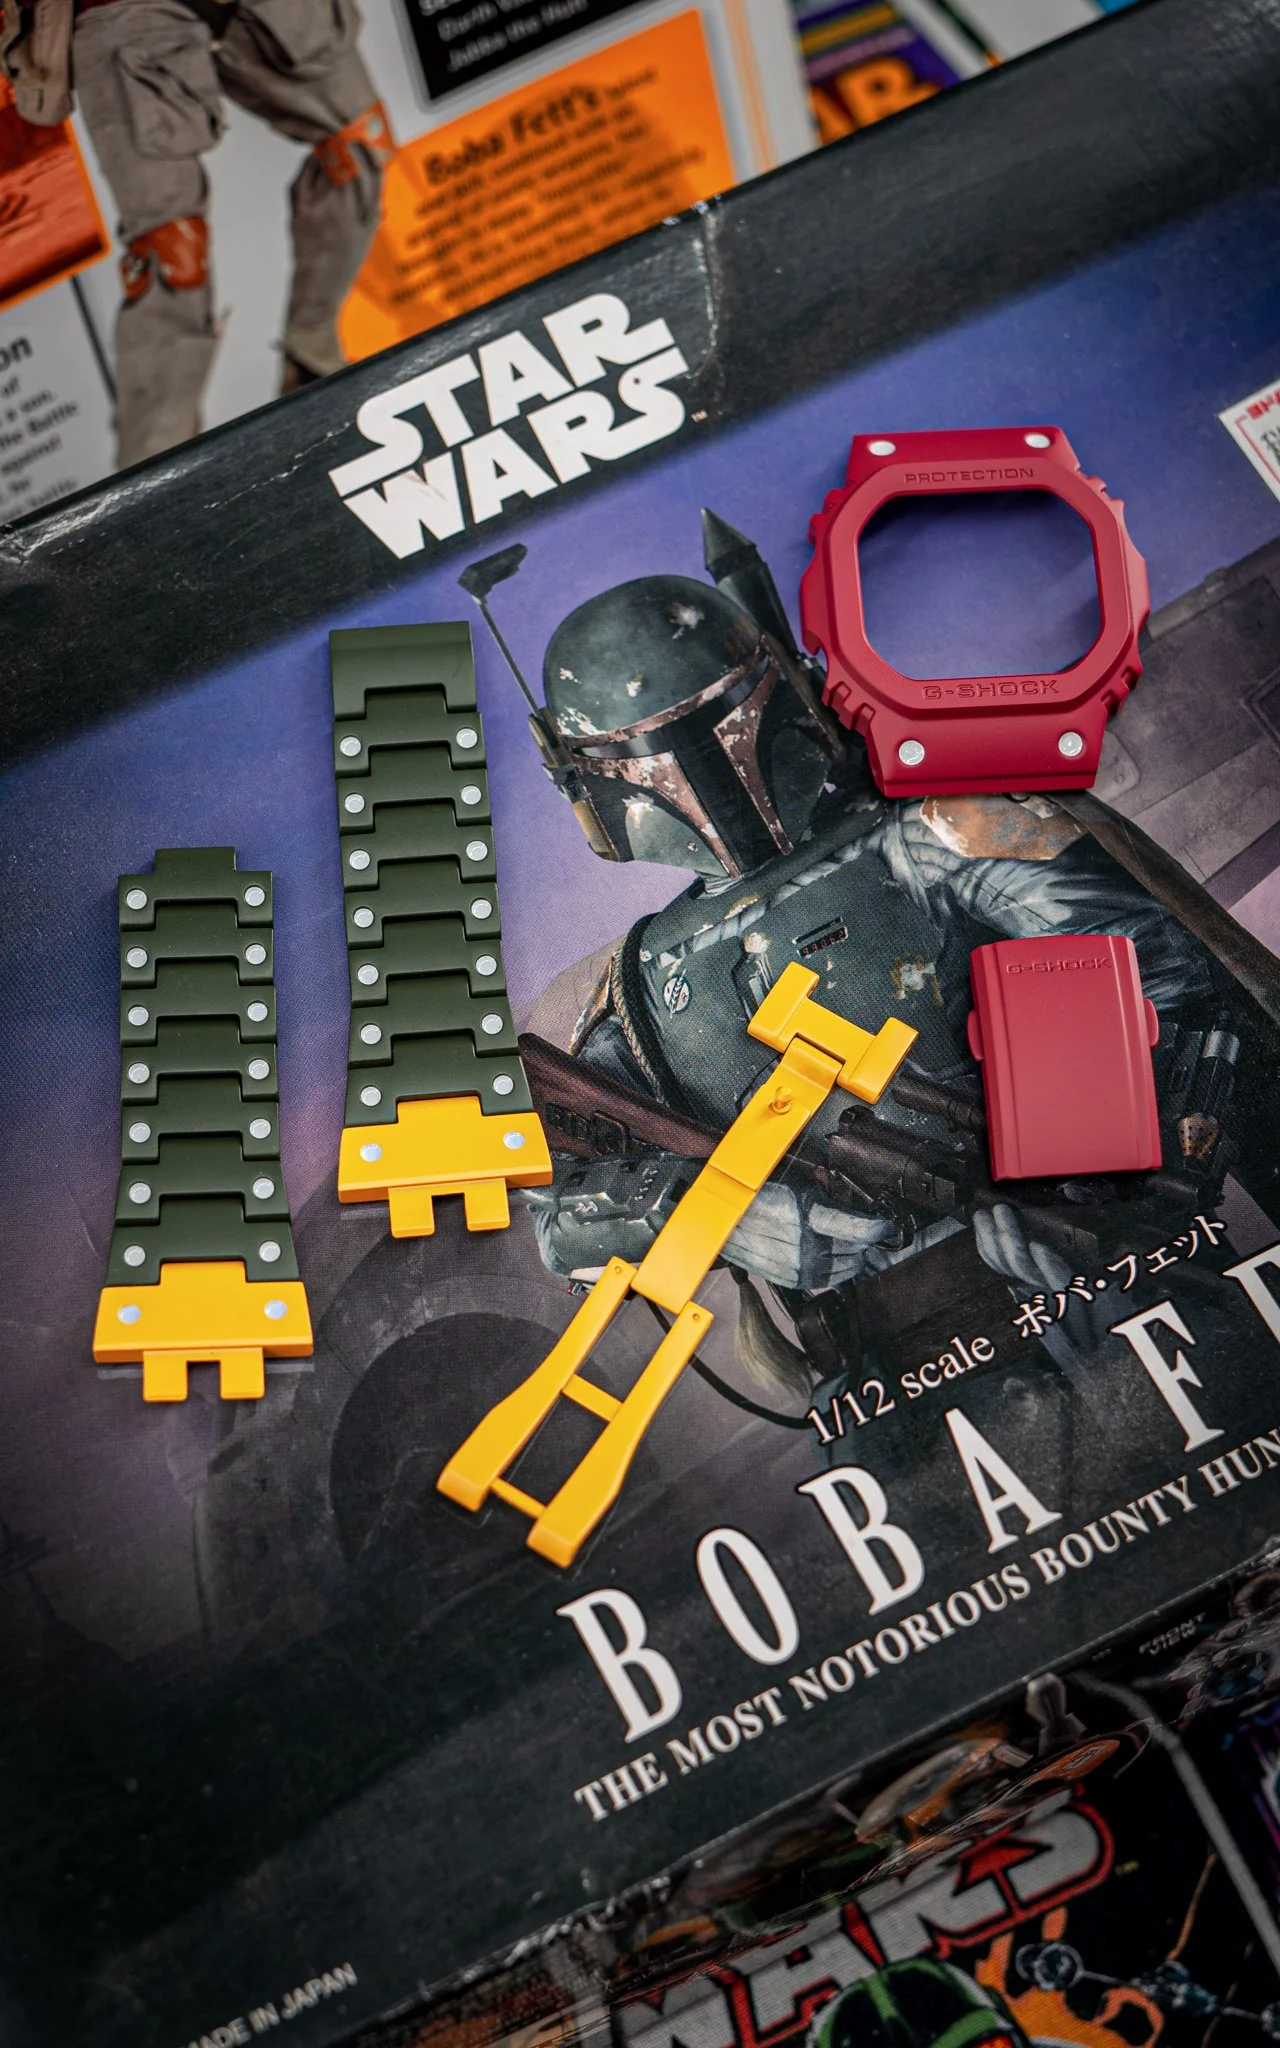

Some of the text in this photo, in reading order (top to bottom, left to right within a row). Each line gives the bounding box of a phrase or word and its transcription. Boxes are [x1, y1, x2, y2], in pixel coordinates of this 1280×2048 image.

[423, 133, 505, 186] Boba
[328, 293, 675, 497] STAR
[343, 346, 690, 559] WARS
[904, 467, 1034, 484] PROTECTION
[922, 679, 1060, 700] G-SHOCK
[1006, 957, 1111, 975] G-SHOCK
[805, 1378, 896, 1445] 1/12
[900, 1335, 996, 1399] scale
[556, 1408, 1064, 1744] BOBA
[574, 1752, 669, 1822] THE
[666, 1687, 789, 1776] MOST
[789, 1563, 1032, 1710] NOTORIOUS
[1030, 1475, 1199, 1584] BOUNTY
[248, 2001, 280, 2034] IN
[281, 1961, 358, 2019] JAPAN
